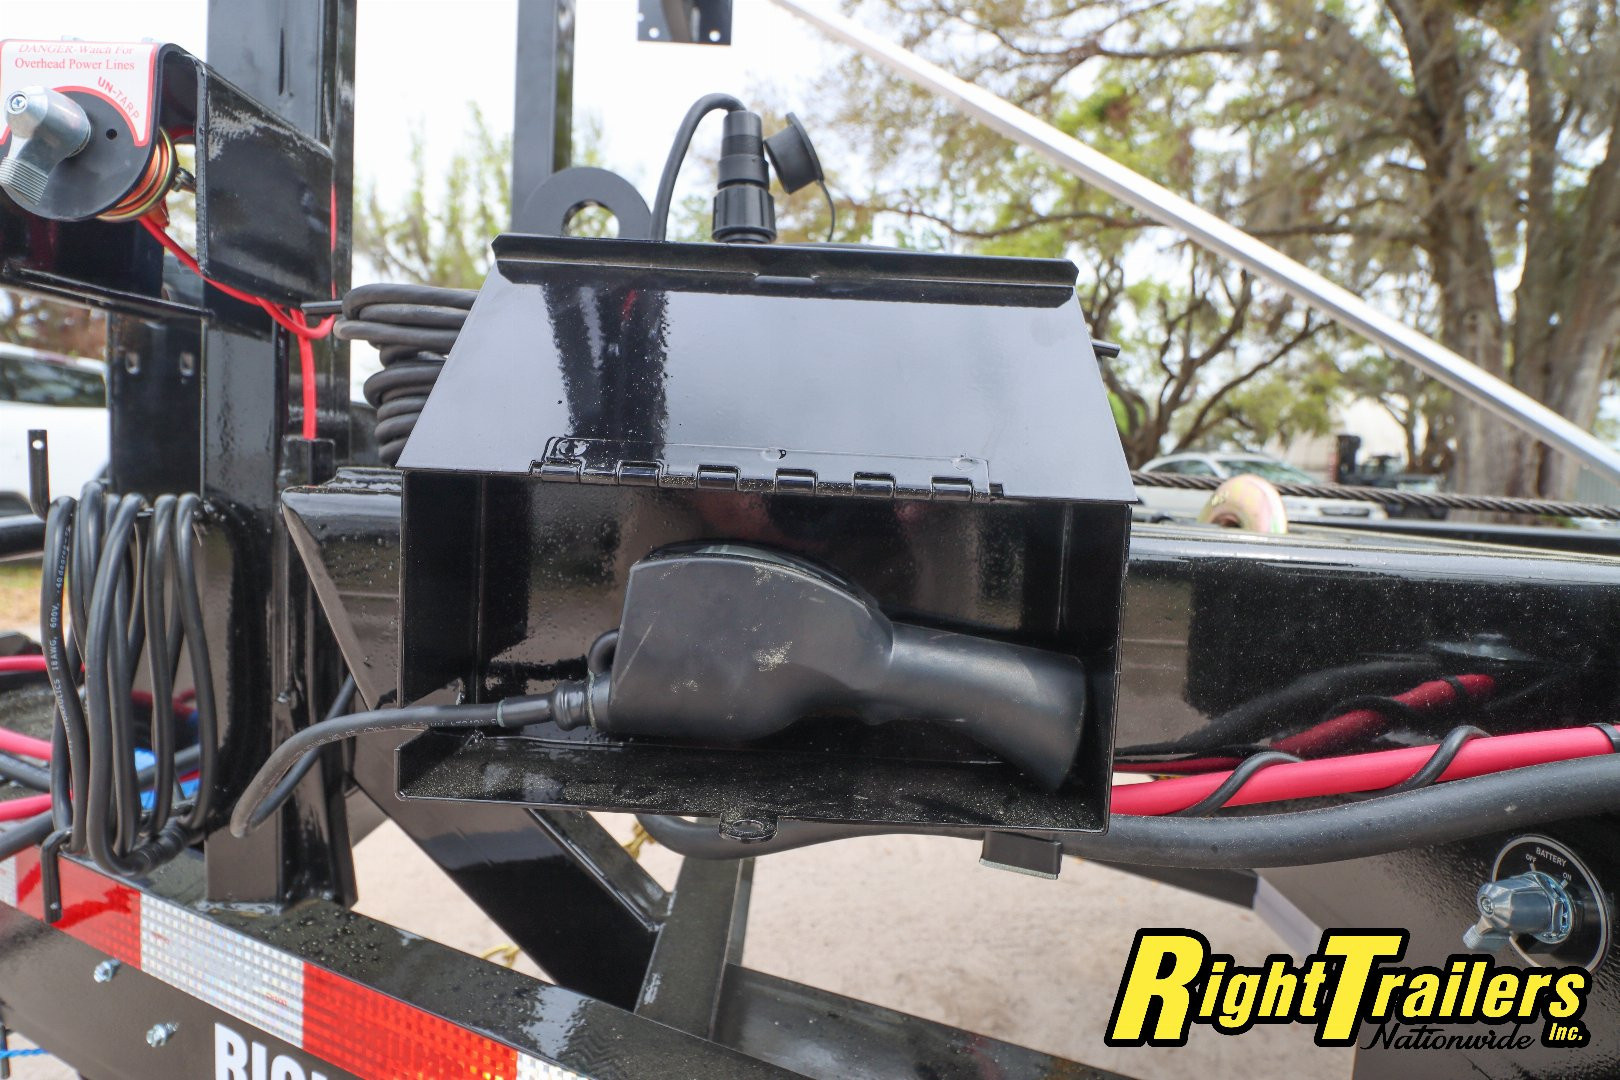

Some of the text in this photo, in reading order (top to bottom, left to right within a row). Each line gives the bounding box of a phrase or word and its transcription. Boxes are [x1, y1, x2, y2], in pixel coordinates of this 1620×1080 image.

[15, 57, 135, 70] Overhead Power Lines
[97, 76, 140, 119] UN-TARP
[1525, 853, 1537, 863] OFF
[1535, 846, 1567, 867] BATTERY
[1562, 872, 1572, 881] ON
